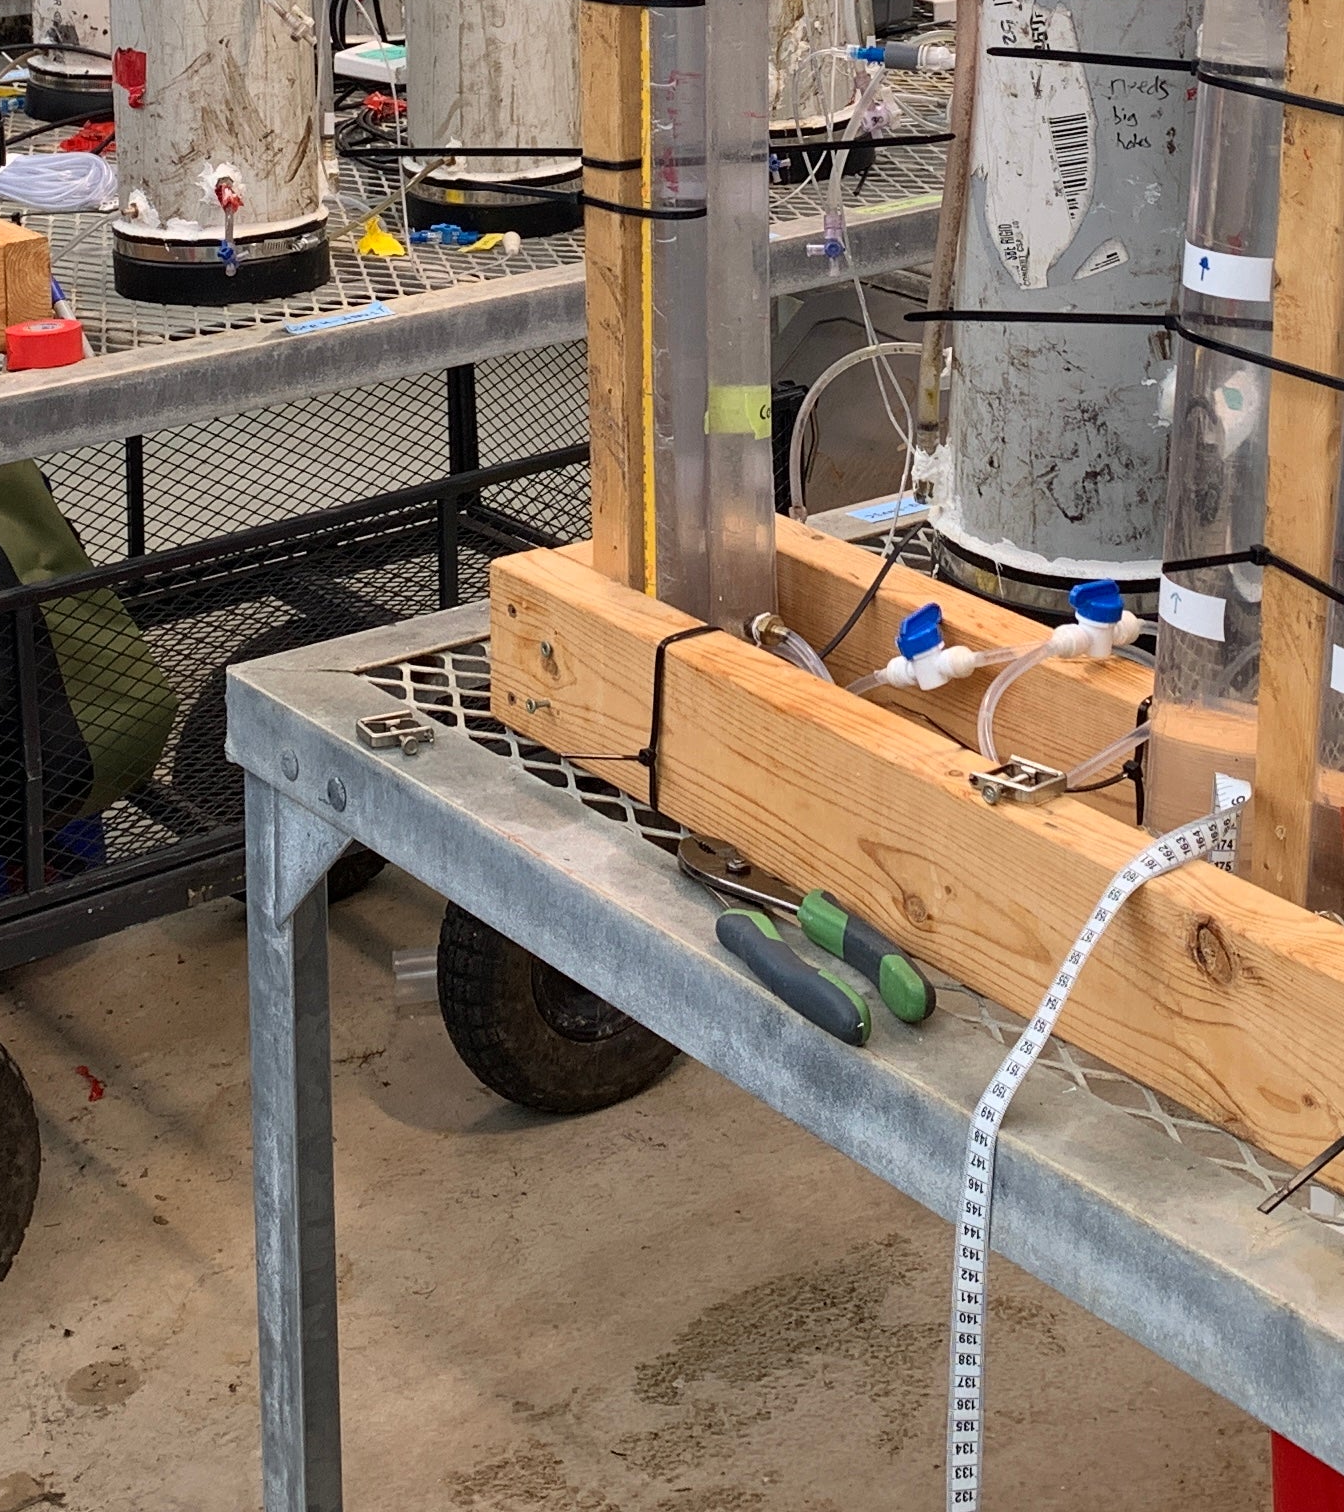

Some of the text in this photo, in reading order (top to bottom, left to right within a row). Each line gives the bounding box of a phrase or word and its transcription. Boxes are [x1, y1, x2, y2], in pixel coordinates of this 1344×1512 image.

[1112, 107, 1138, 126] big
[1176, 836, 1191, 856] 163
[1192, 830, 1206, 849] 164
[1158, 844, 1175, 861] 162
[1140, 856, 1157, 869] 161
[1122, 870, 1137, 883] 160
[1107, 889, 1123, 902] 159
[1033, 1019, 1047, 1033] 153
[1019, 1041, 1034, 1055] 152
[1006, 1062, 1021, 1077] 151
[992, 1084, 1007, 1099] 150
[980, 1106, 996, 1122] 149
[974, 1130, 988, 1147] 148
[970, 1154, 986, 1171] 147
[968, 1178, 984, 1194] 146
[966, 1202, 982, 1217] 145
[964, 1225, 981, 1239] 144
[962, 1247, 981, 1261] 143
[961, 1269, 980, 1283] 142
[960, 1292, 979, 1304] 141
[959, 1312, 979, 1325] 140
[958, 1333, 978, 1345] 139
[958, 1354, 978, 1366] 138
[957, 1377, 977, 1388] 137
[956, 1399, 977, 1411] 136
[955, 1420, 975, 1432] 135
[955, 1443, 975, 1455] 134
[954, 1467, 974, 1479] 133
[954, 1491, 974, 1503] 132
